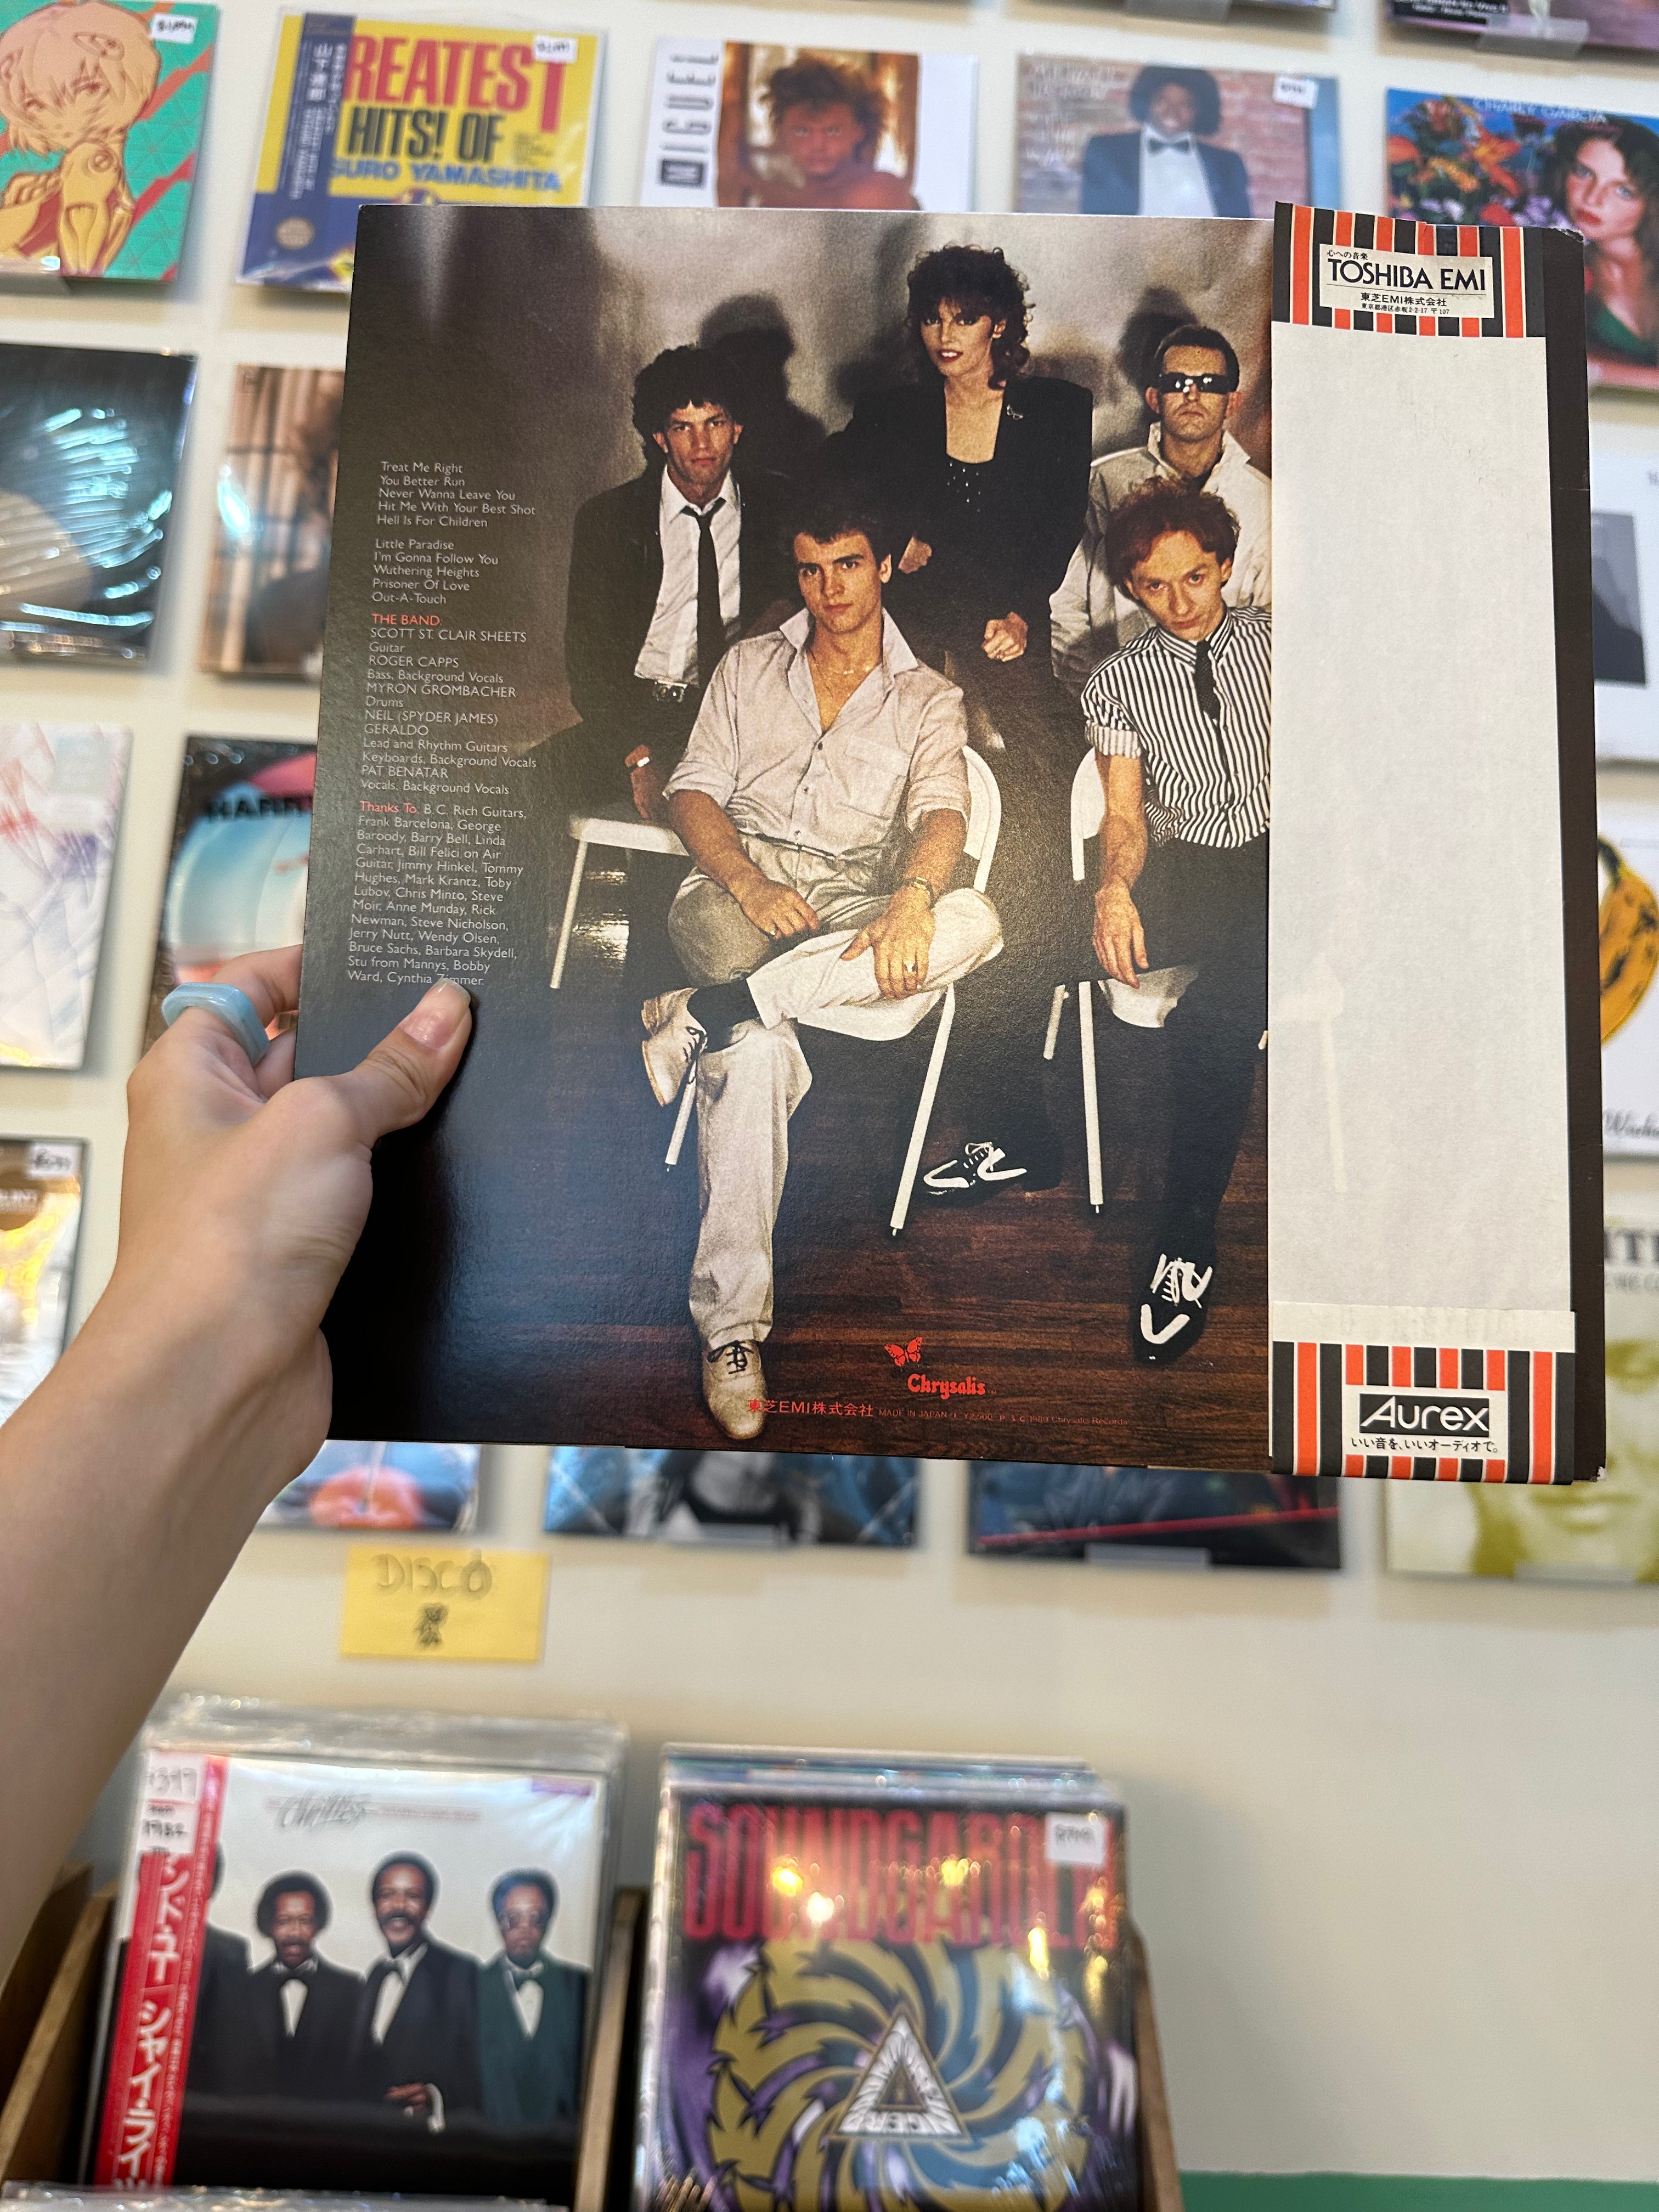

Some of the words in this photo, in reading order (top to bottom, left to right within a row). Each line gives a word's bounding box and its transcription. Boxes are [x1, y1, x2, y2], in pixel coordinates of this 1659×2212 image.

[347, 105, 447, 159] HITS!
[459, 113, 506, 163] OF
[1326, 250, 1368, 259] 心への音楽
[1328, 258, 1433, 289] TOSHIBA
[1440, 268, 1485, 290] EMI
[1361, 292, 1447, 307] 東芝EMI株式会社
[381, 461, 408, 472] Treat
[413, 462, 430, 472] Me
[434, 463, 463, 476] Right
[380, 475, 399, 486] You
[404, 476, 440, 486] Better
[444, 477, 465, 487] Run
[379, 488, 414, 498] Never
[418, 489, 455, 499] Wanna
[460, 489, 492, 500] Leave
[496, 490, 515, 500] You
[379, 501, 395, 511] Hit
[400, 502, 416, 511] Me
[421, 502, 449, 512] With
[454, 503, 478, 513] Your
[482, 504, 506, 514] Best
[511, 504, 535, 515] Shot
[377, 515, 399, 524] Hell
[404, 515, 411, 525] Is
[416, 516, 435, 526] For
[439, 516, 488, 527] Children
[375, 539, 404, 549] Little
[409, 540, 454, 550] Paradise
[374, 552, 391, 562] I'm
[396, 552, 431, 563] Gonna
[436, 553, 473, 564] Follow
[478, 554, 498, 565] You
[374, 565, 432, 578] Wuthering
[437, 567, 479, 579] Heights
[373, 578, 420, 589] Prisoner
[424, 579, 439, 590] Of
[443, 580, 470, 591] Love
[372, 592, 446, 604] Out-A-Touch
[372, 613, 396, 625] THE
[370, 628, 415, 639] SCOTT
[439, 630, 476, 641] CLAIR
[481, 630, 527, 642] SHEETS
[369, 642, 405, 652] Guitar
[369, 656, 414, 666] ROGER
[418, 657, 459, 668] CAPPS
[398, 670, 464, 684] Background
[470, 672, 504, 683] Vocals
[366, 683, 416, 694] MYRON
[421, 685, 516, 698] GROMBACHER
[365, 696, 404, 707] Drums
[365, 710, 394, 721] NEIL
[398, 711, 452, 724] (SPYDER
[454, 713, 498, 726] JAMES)
[364, 724, 428, 736] GERALDO
[363, 738, 389, 748] Lead
[394, 740, 413, 749] and
[417, 740, 461, 752] Rhythm
[466, 741, 507, 752] Guitars
[430, 754, 497, 766] Background
[501, 757, 537, 768] Vocals
[362, 766, 384, 776] PAT
[388, 766, 448, 778] BENATAR
[403, 780, 470, 795] Background
[475, 783, 509, 794] Vocals
[360, 800, 398, 812] Thanks
[454, 805, 477, 816] Rich
[482, 806, 527, 819] Guitars,
[359, 816, 390, 827] Frank
[458, 820, 501, 833] George
[411, 832, 442, 845] Barry
[476, 834, 505, 845] Linda
[409, 845, 426, 856] Bill
[464, 850, 478, 859] on
[482, 850, 501, 859] Air
[397, 859, 432, 872] Jimmy
[482, 862, 523, 877] Tommy
[405, 874, 434, 884] Mark
[485, 877, 512, 890] Toby
[396, 888, 426, 899] Chris
[472, 890, 504, 901] Steve
[386, 901, 417, 912] Anne
[472, 905, 496, 915] Rick
[352, 914, 407, 927] Newman,
[411, 917, 443, 928] Steve
[448, 918, 508, 932] Nicholson,
[348, 928, 378, 941] Jerry
[419, 932, 459, 944] Wendy
[463, 932, 500, 945] Olsen,
[349, 941, 383, 953] Bruce
[387, 943, 420, 956] Sachs,
[426, 945, 470, 957] Barbara
[474, 947, 516, 960] Skydell,
[348, 956, 366, 967] Stu
[371, 957, 398, 968] from
[404, 958, 449, 972] Mannys,
[453, 960, 490, 974] Bobby
[348, 970, 382, 983] Ward,
[387, 972, 432, 987] Cynthia
[907, 1373, 986, 1400] Chrysalis
[747, 1399, 874, 1417] 東芝EMI株式会社
[1359, 1396, 1488, 1431] Aurex
[1351, 1437, 1498, 1453] いい音を、いいオーディオで。
[375, 1553, 493, 1598] DISCO
